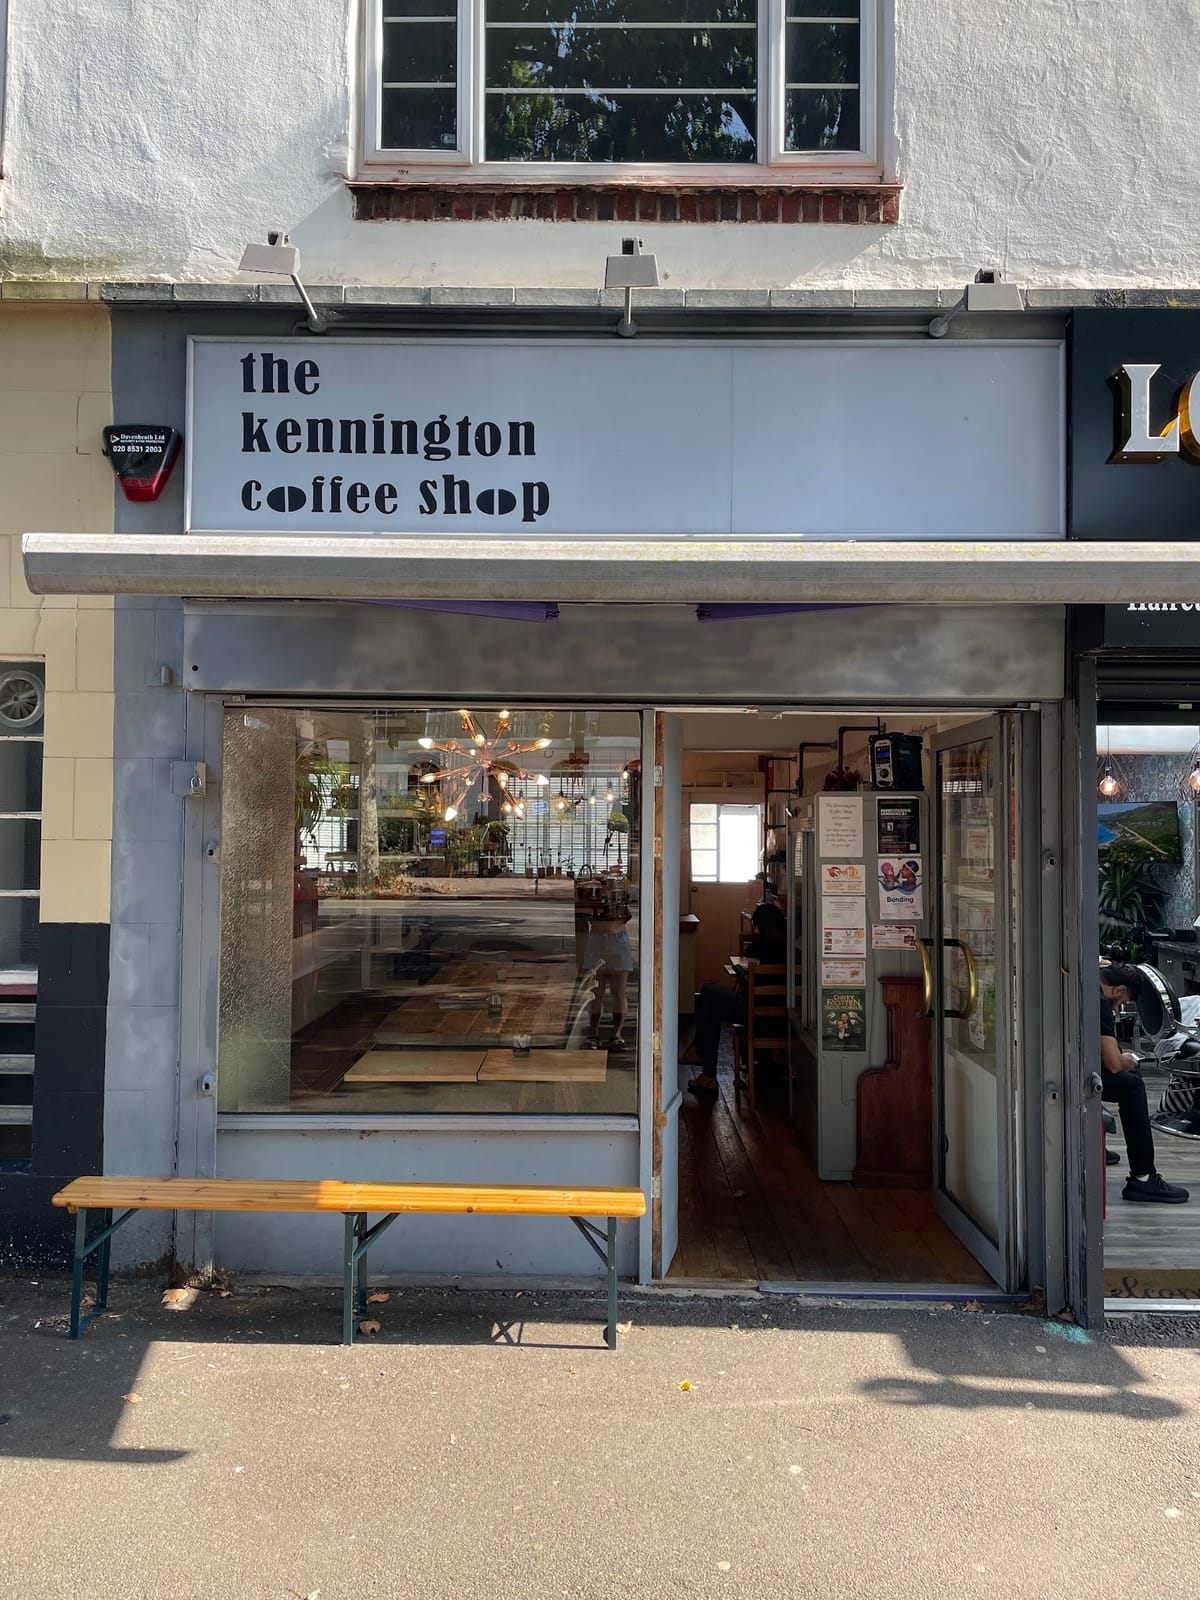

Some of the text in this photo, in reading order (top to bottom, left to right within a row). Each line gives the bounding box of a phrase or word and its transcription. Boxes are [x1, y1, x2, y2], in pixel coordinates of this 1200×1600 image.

[240, 353, 319, 395] the
[1115, 364, 1200, 458] L
[242, 413, 535, 461] kennington
[242, 475, 549, 522] coffee shop
[887, 896, 914, 904] Bonding
